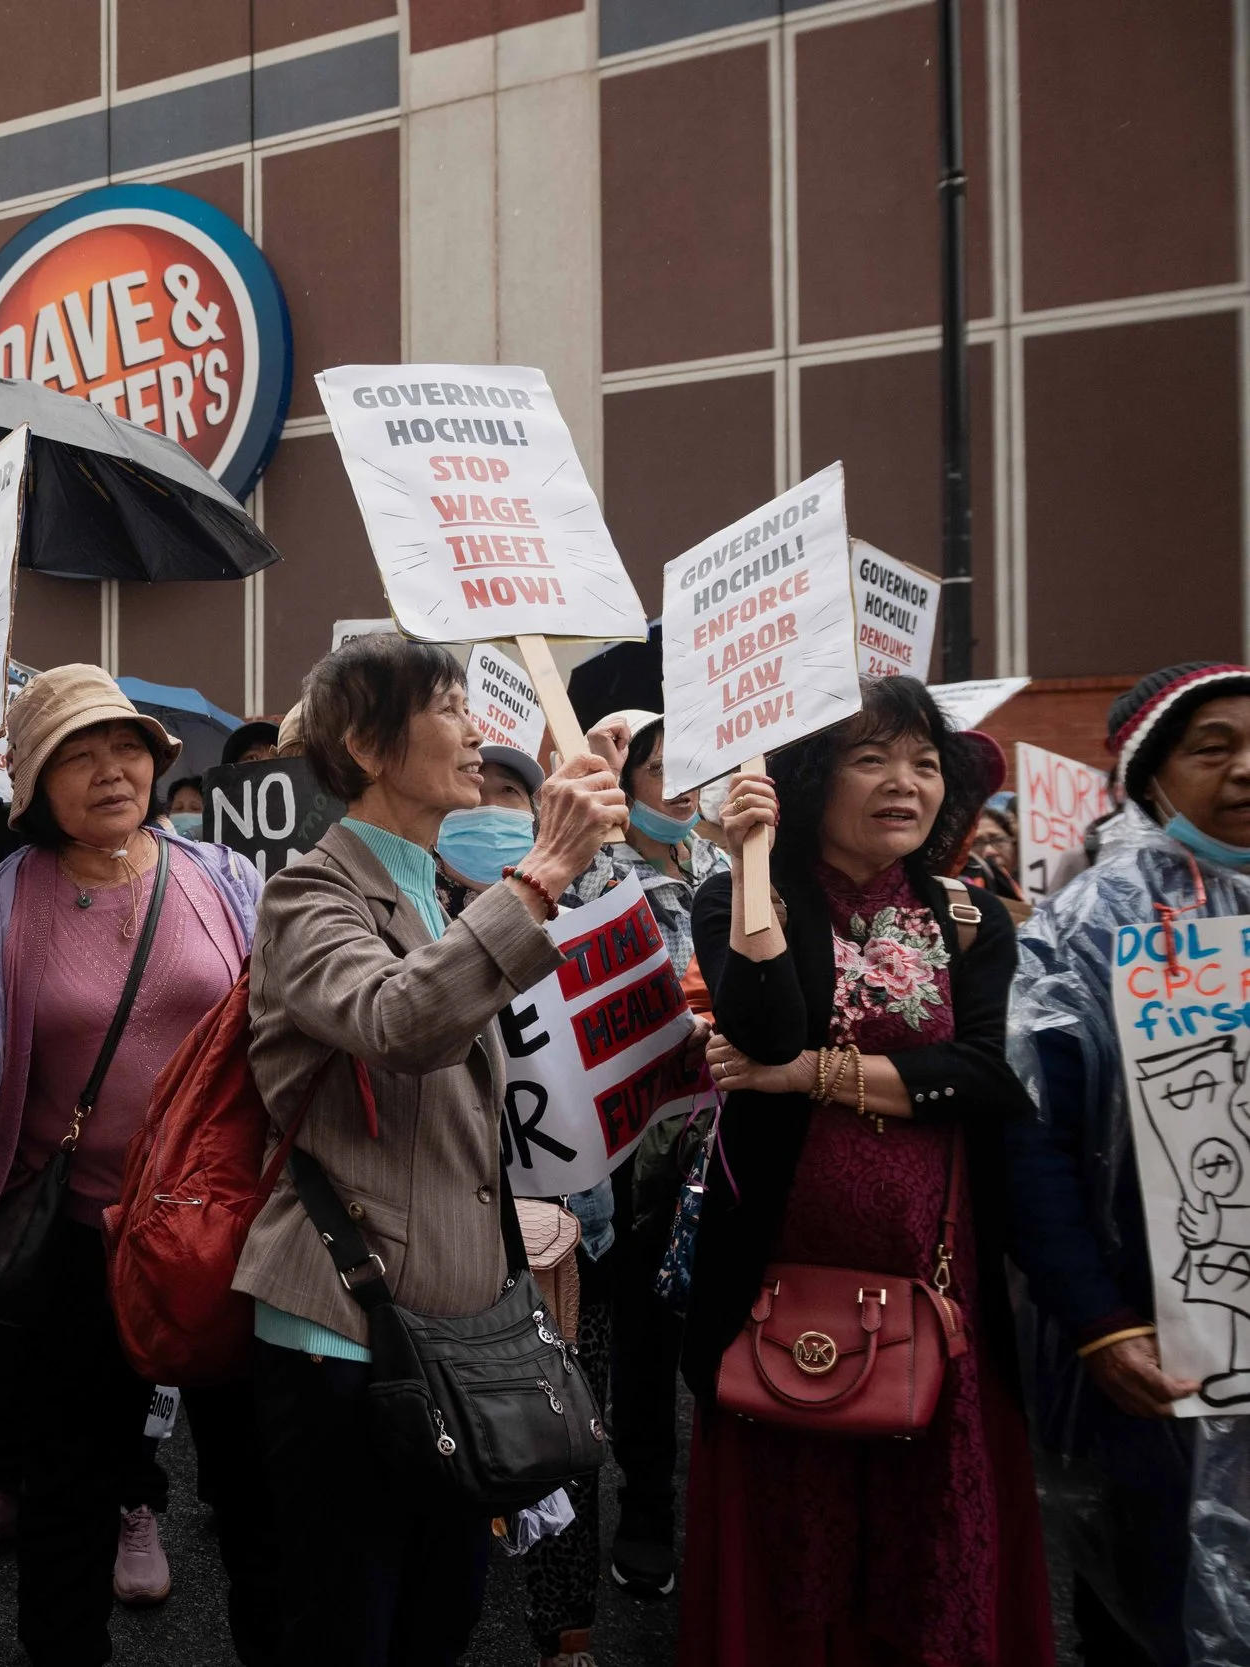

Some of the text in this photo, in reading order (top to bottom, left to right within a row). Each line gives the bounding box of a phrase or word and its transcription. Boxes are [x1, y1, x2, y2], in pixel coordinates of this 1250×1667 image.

[164, 263, 226, 349] &
[88, 348, 230, 443] TER'S
[352, 382, 535, 411] GOVERNOR
[385, 418, 529, 447] HOCHUL!
[429, 455, 510, 483] STOP
[430, 494, 537, 524] WAGE
[446, 534, 550, 564] THEFT
[680, 493, 821, 590] GOVERNOR
[460, 576, 566, 610] NOW!
[693, 534, 805, 616] HOCHUL!
[860, 558, 929, 611] GOVERNOR
[693, 568, 811, 652] ENFORCE
[864, 591, 918, 636] HOCHUL!
[707, 612, 797, 681] LABOR
[859, 623, 913, 664] DENOUNCE
[482, 678, 531, 722] HOCHUL!
[722, 656, 784, 707] LAW
[486, 703, 517, 731] STOP
[716, 690, 795, 751] NOW!
[211, 771, 296, 845] NO
[1024, 752, 1116, 823] WORK
[563, 906, 659, 985] TIME
[1117, 923, 1223, 967] DOL
[1127, 962, 1227, 1001] CPC
[797, 1339, 831, 1363] MK
